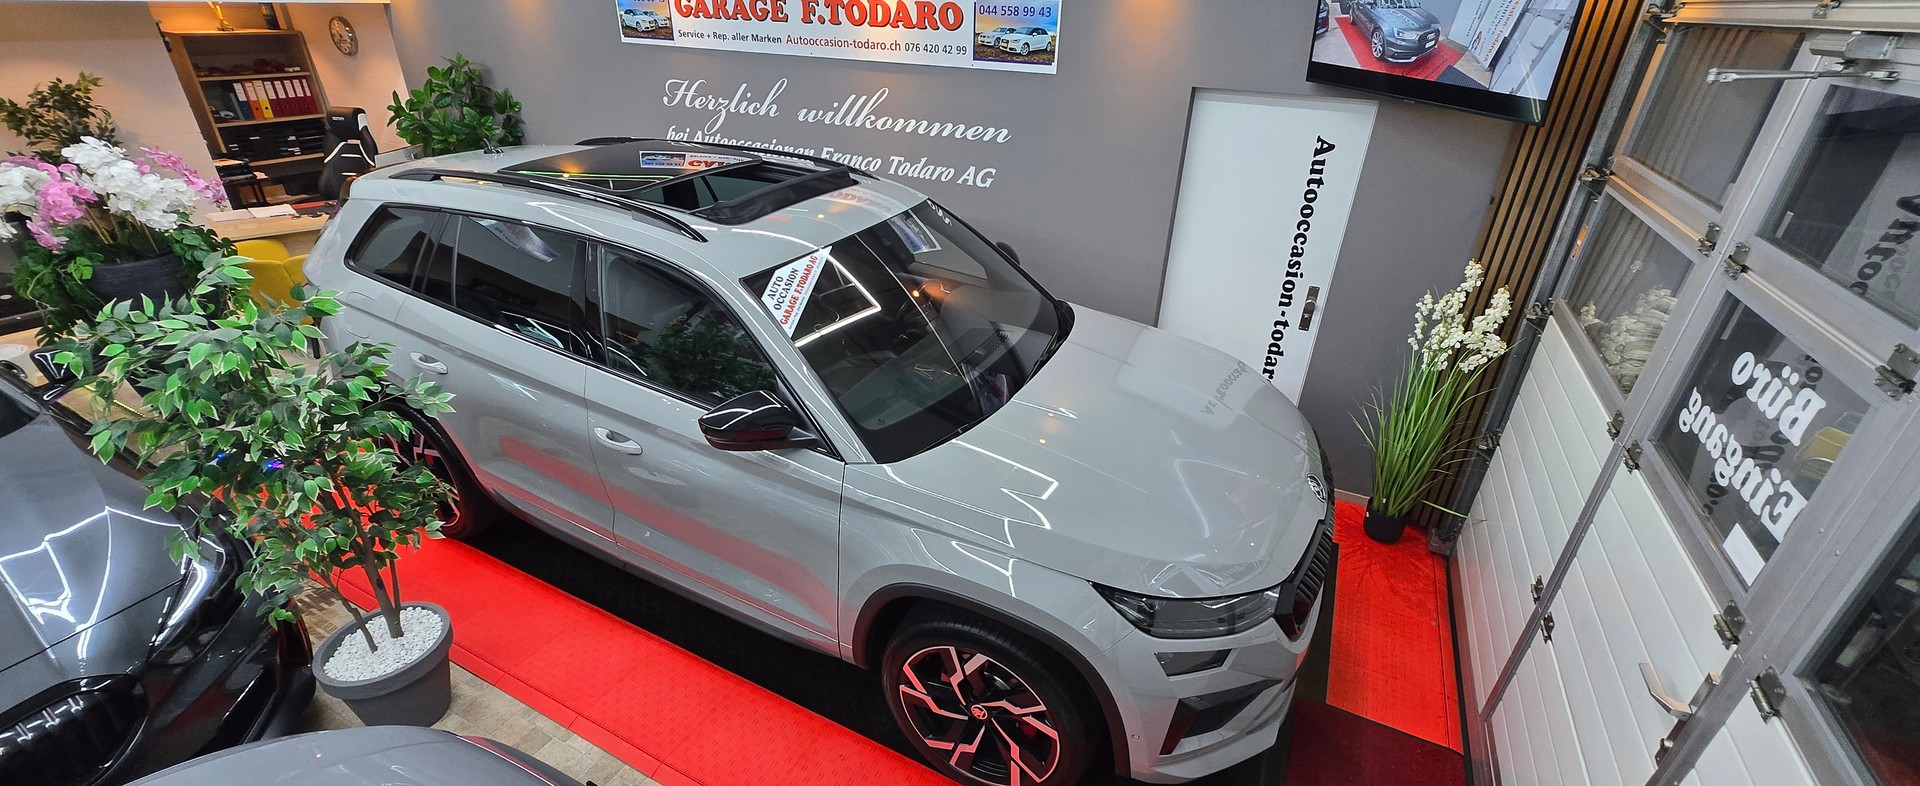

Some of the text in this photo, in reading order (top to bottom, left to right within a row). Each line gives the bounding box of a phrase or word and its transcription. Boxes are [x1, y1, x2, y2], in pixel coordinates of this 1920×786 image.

[674, 0, 964, 31] GARAGE F.TODARO
[979, 4, 1052, 18] 044 558 99 43
[678, 29, 705, 39] Service
[712, 31, 730, 42] Rep.
[731, 33, 749, 42] aller
[751, 34, 782, 44] Marken
[785, 34, 901, 52] Autooccasion-todaro.ch
[904, 42, 921, 53] 076
[923, 43, 940, 54] 420
[941, 45, 954, 55] 42
[956, 45, 968, 55] 99
[662, 77, 1012, 143] Herzlich willkommen
[821, 146, 882, 172] Franco
[887, 156, 955, 182] Todaro
[956, 166, 997, 188] AG
[1262, 135, 1336, 383] Autooccasion-todar
[767, 276, 784, 301] AUTO
[773, 267, 800, 311] OCCASION
[779, 294, 800, 325] GARAGE
[810, 255, 818, 266] AG
